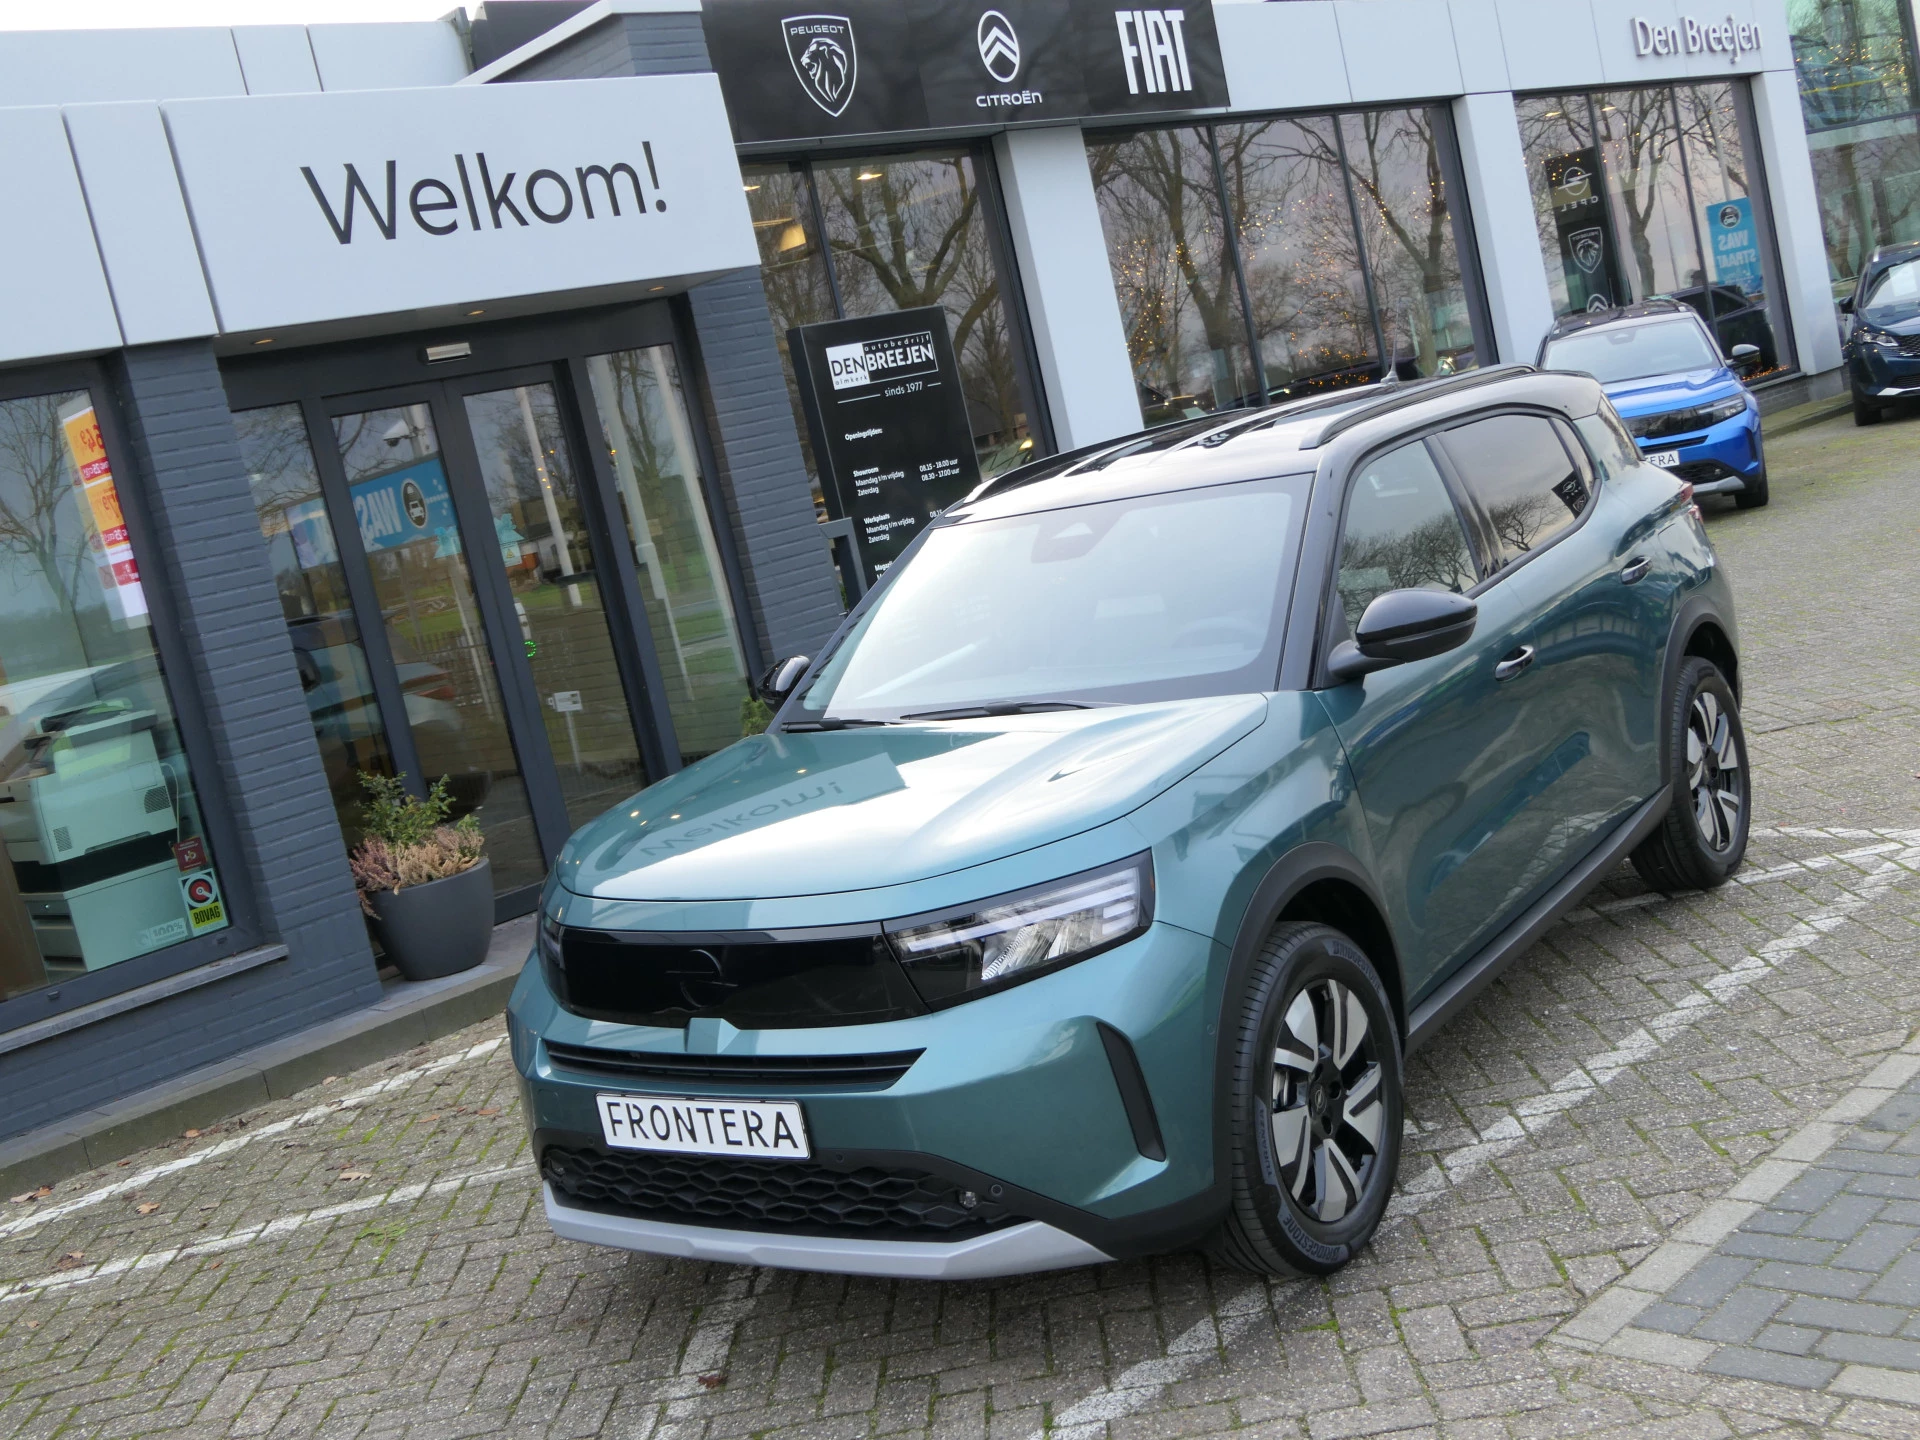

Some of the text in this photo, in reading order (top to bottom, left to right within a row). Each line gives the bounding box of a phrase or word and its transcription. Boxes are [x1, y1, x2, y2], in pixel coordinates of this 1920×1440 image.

[790, 25, 844, 36] PEUGEOT
[1630, 13, 1763, 65] Den Breejen
[1115, 10, 1192, 94] FIAT
[300, 141, 668, 245] Welkom!
[864, 334, 929, 351] autobedrijf
[830, 343, 934, 376] DEN BREEJEN
[885, 381, 923, 397] sinds 1977
[1645, 453, 1676, 467] ERA
[193, 905, 220, 924] BOVAG
[606, 1101, 800, 1150] FRONTERA
[1282, 1214, 1341, 1262] BRIDGESTONE
